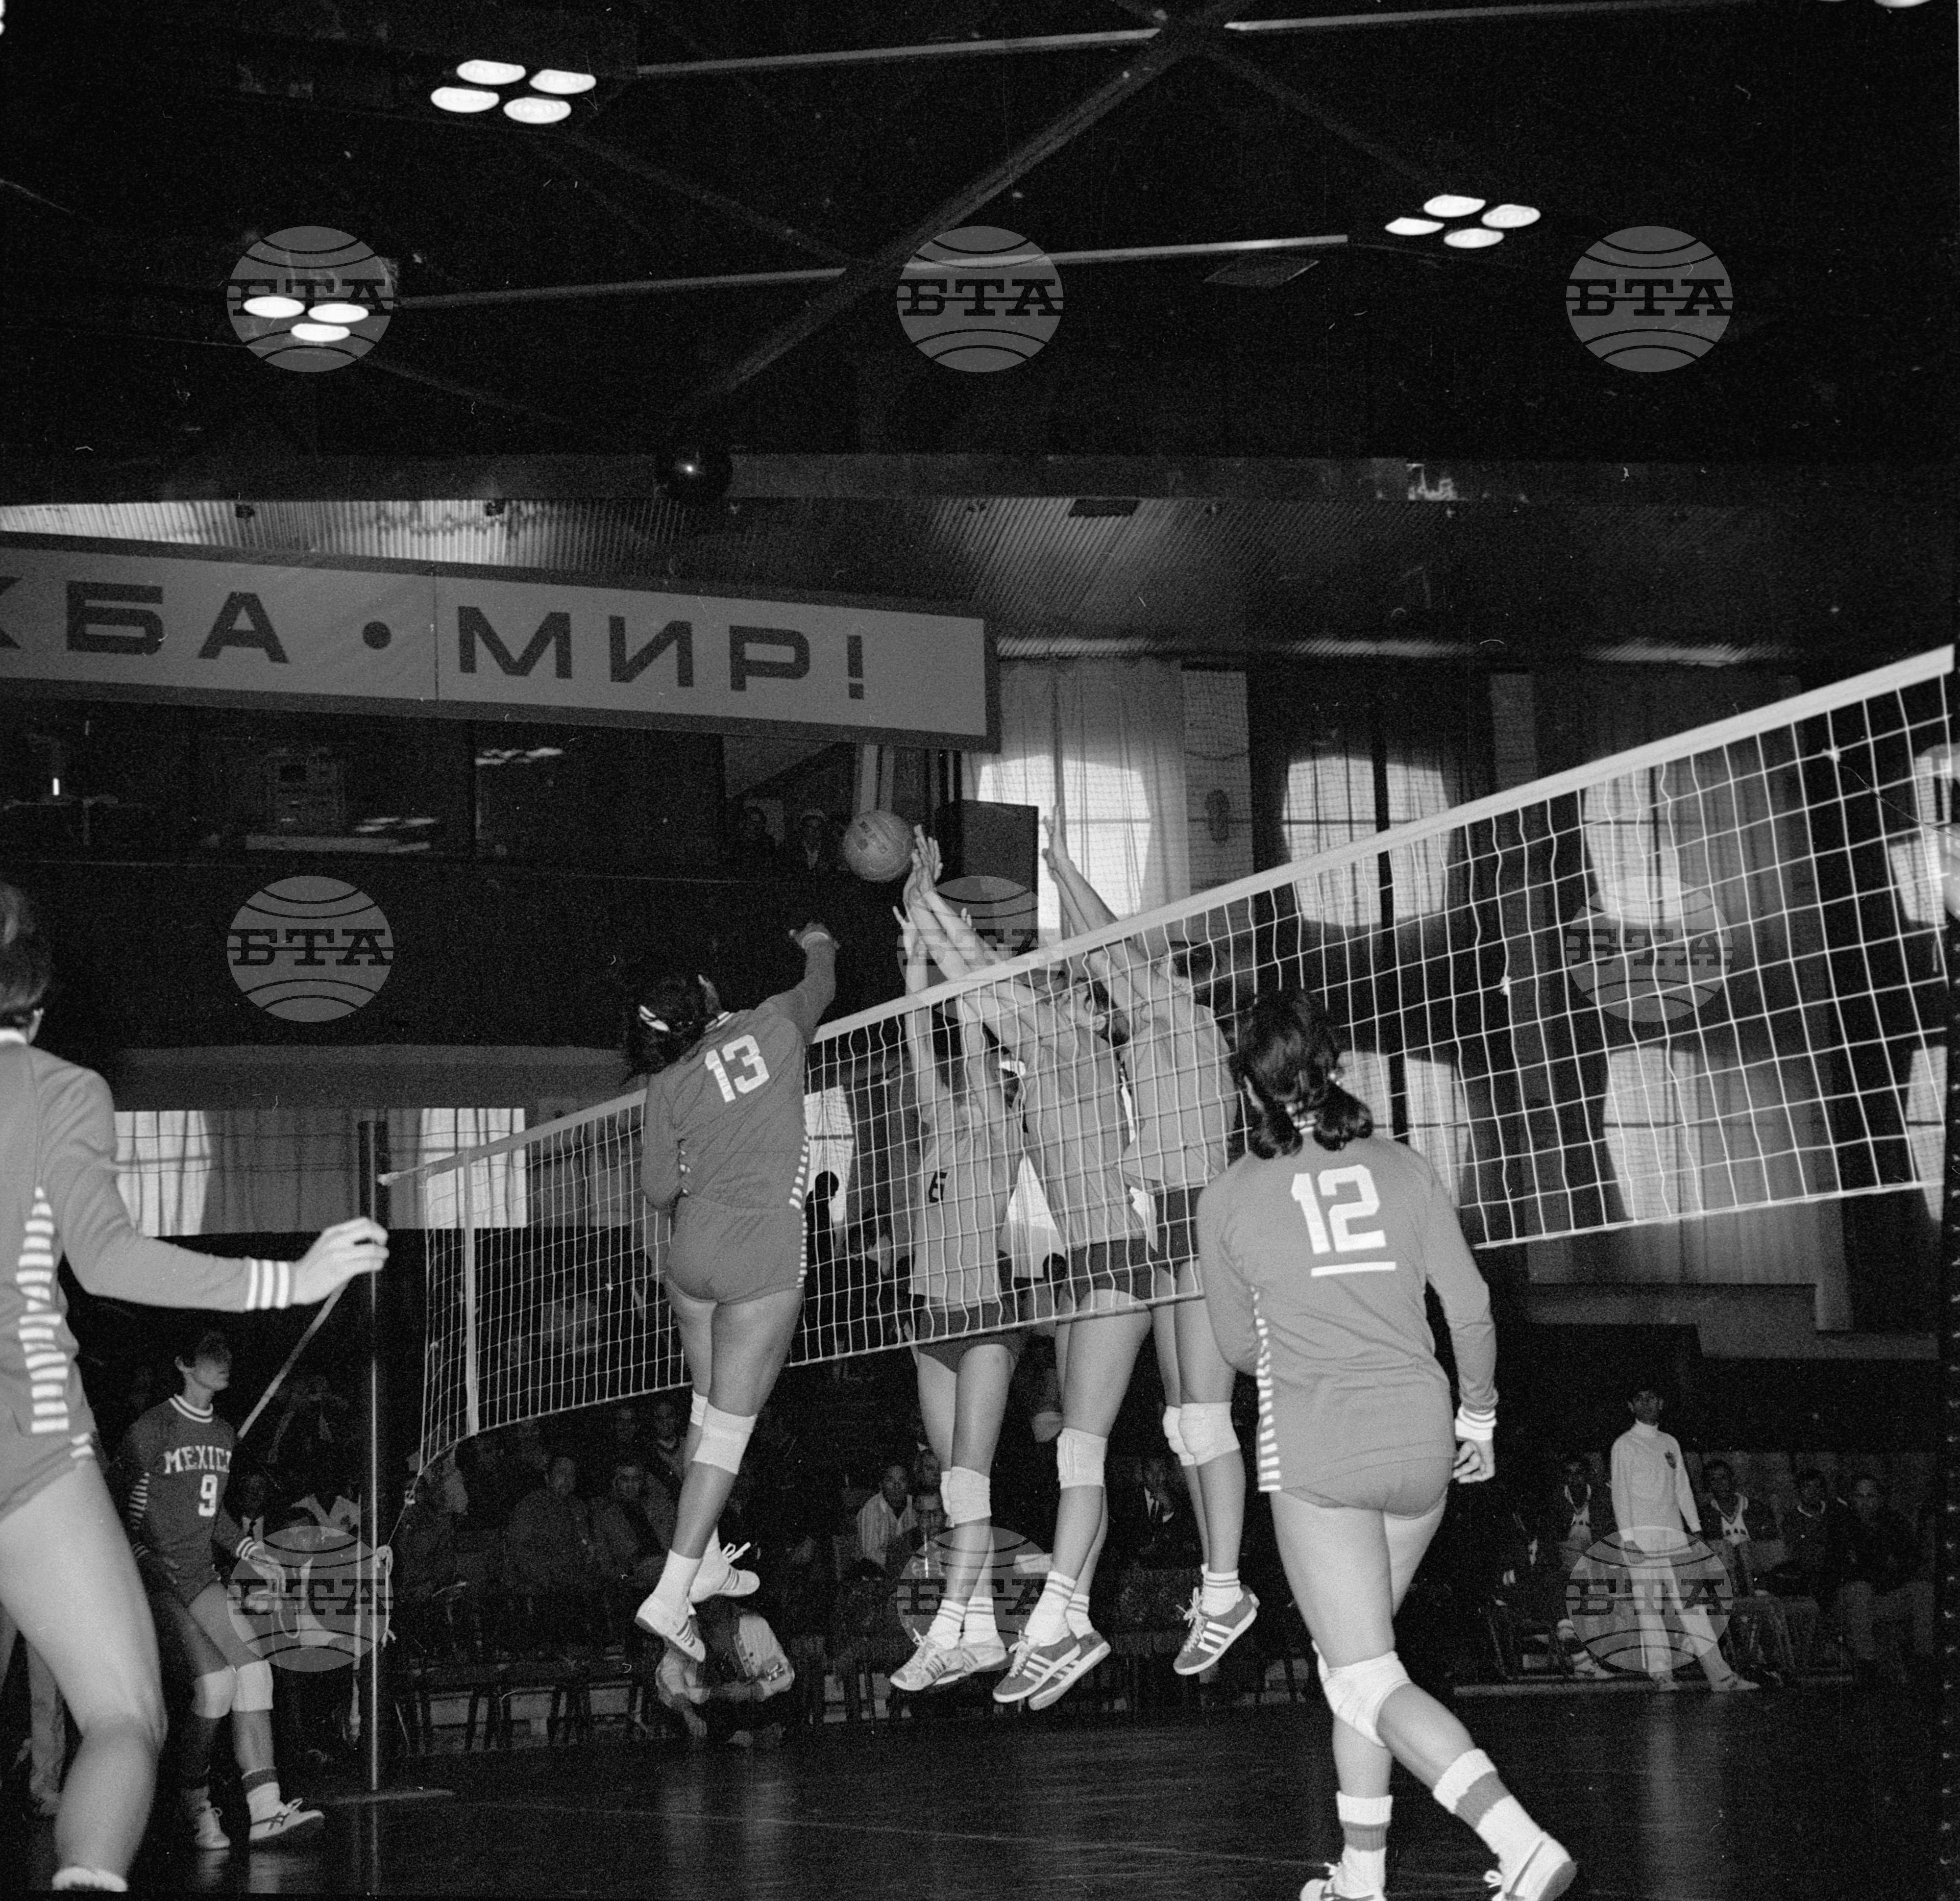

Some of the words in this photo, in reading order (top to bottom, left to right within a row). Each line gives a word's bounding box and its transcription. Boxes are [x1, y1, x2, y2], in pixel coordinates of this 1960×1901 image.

[0, 576, 289, 664] БА
[458, 606, 864, 700] МИР!
[704, 1034, 770, 1103] 13
[1290, 1164, 1386, 1255] 12
[198, 1474, 218, 1517] 9
